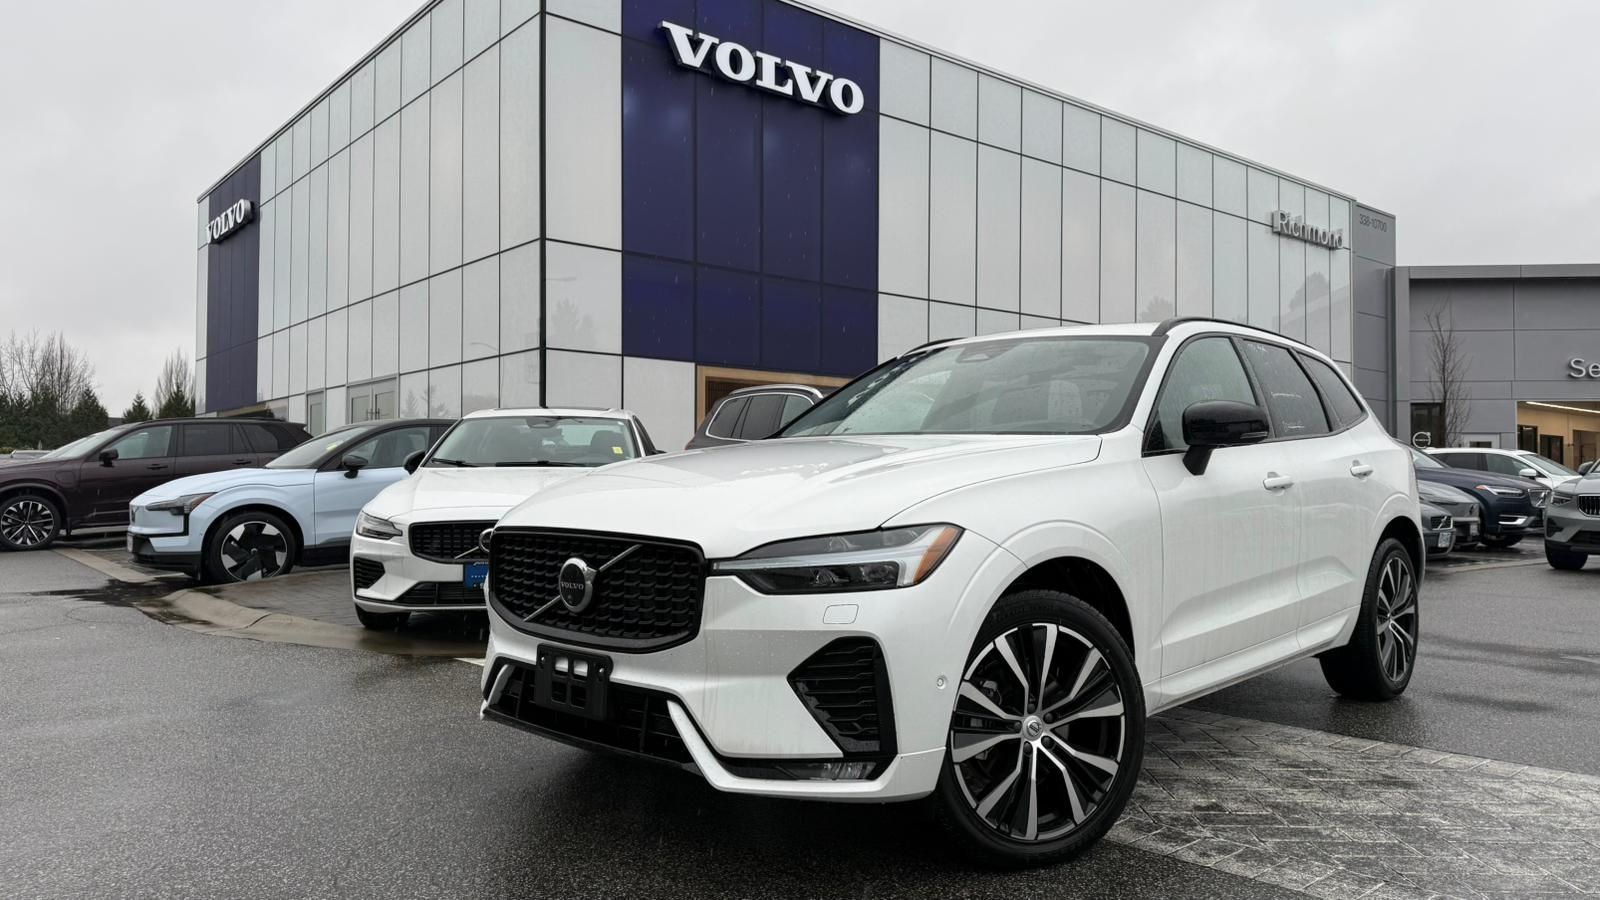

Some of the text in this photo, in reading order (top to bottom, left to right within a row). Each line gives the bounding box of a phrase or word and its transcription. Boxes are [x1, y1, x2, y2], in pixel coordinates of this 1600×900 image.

[660, 20, 865, 114] VOLVO
[206, 198, 246, 244] VOLVO
[1277, 209, 1345, 249] Richmond
[1570, 357, 1600, 378] Se
[561, 581, 585, 590] VOLVO
